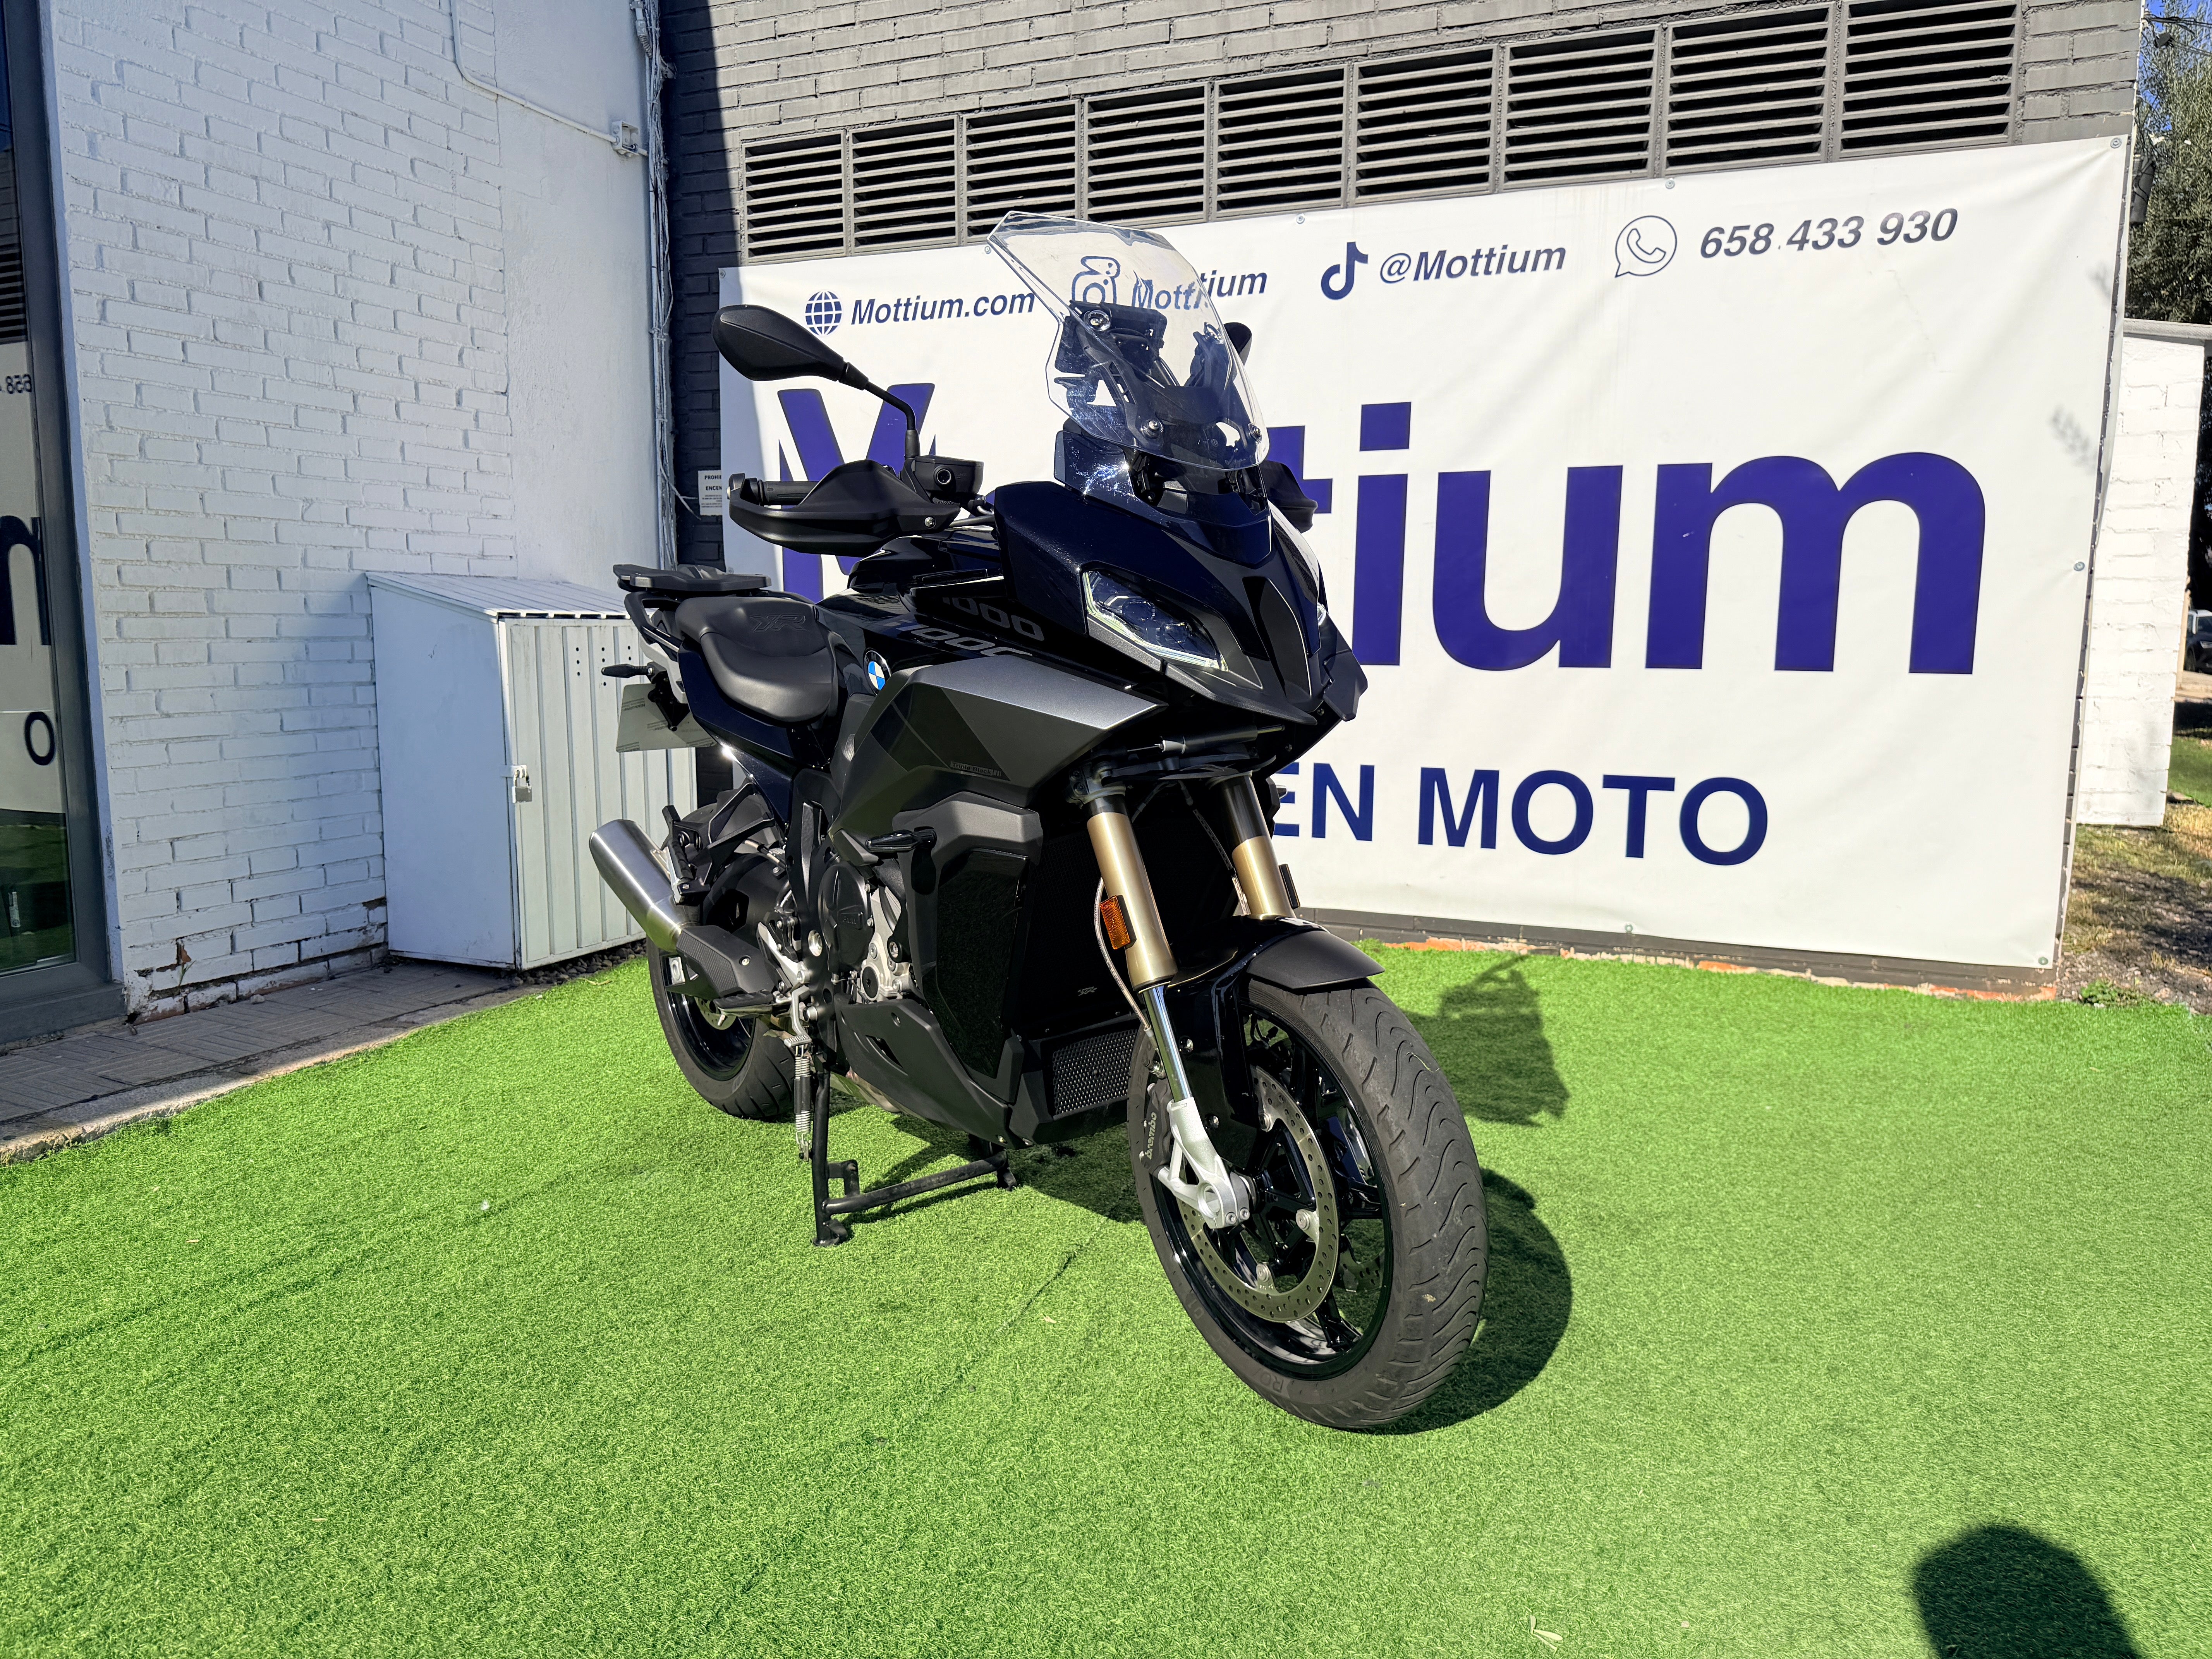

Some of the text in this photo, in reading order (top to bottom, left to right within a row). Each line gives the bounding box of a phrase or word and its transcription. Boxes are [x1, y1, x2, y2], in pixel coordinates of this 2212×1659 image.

[1700, 208, 1958, 258] 658 433 930
[1380, 244, 1566, 284] @Mottium
[851, 292, 1036, 325] Mottium.com
[777, 381, 1985, 674] Mium
[1273, 761, 1768, 866] EN MOTO
[1144, 1112, 1157, 1160] brembo
